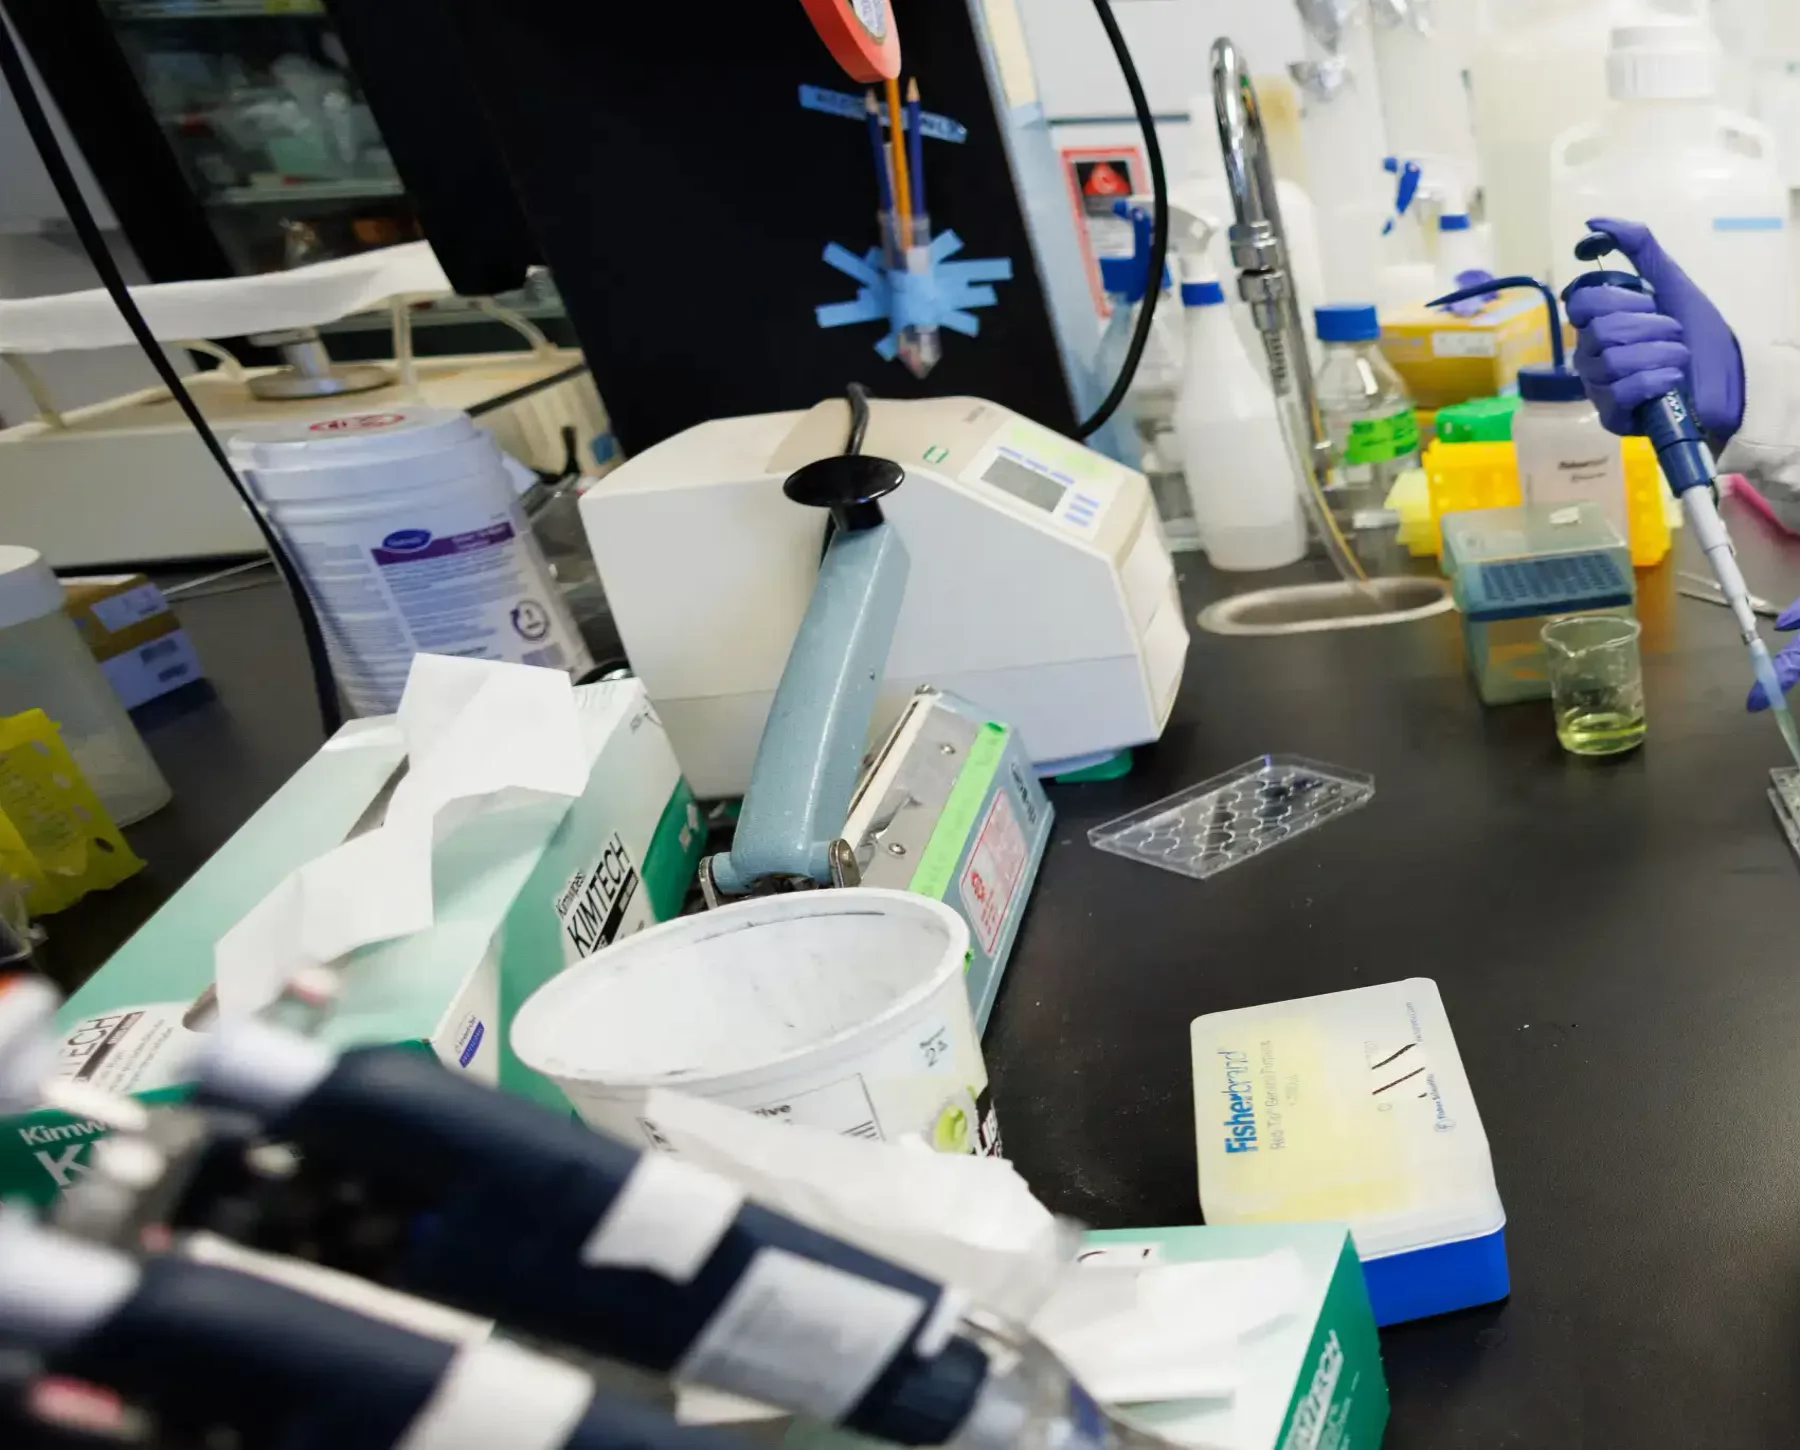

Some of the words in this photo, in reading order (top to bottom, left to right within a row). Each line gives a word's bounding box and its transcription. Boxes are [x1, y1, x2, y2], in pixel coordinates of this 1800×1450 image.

[567, 831, 630, 958] KIMTECH
[18, 1120, 108, 1146] Kimw
[1217, 1050, 1258, 1153] Fisherbrand
